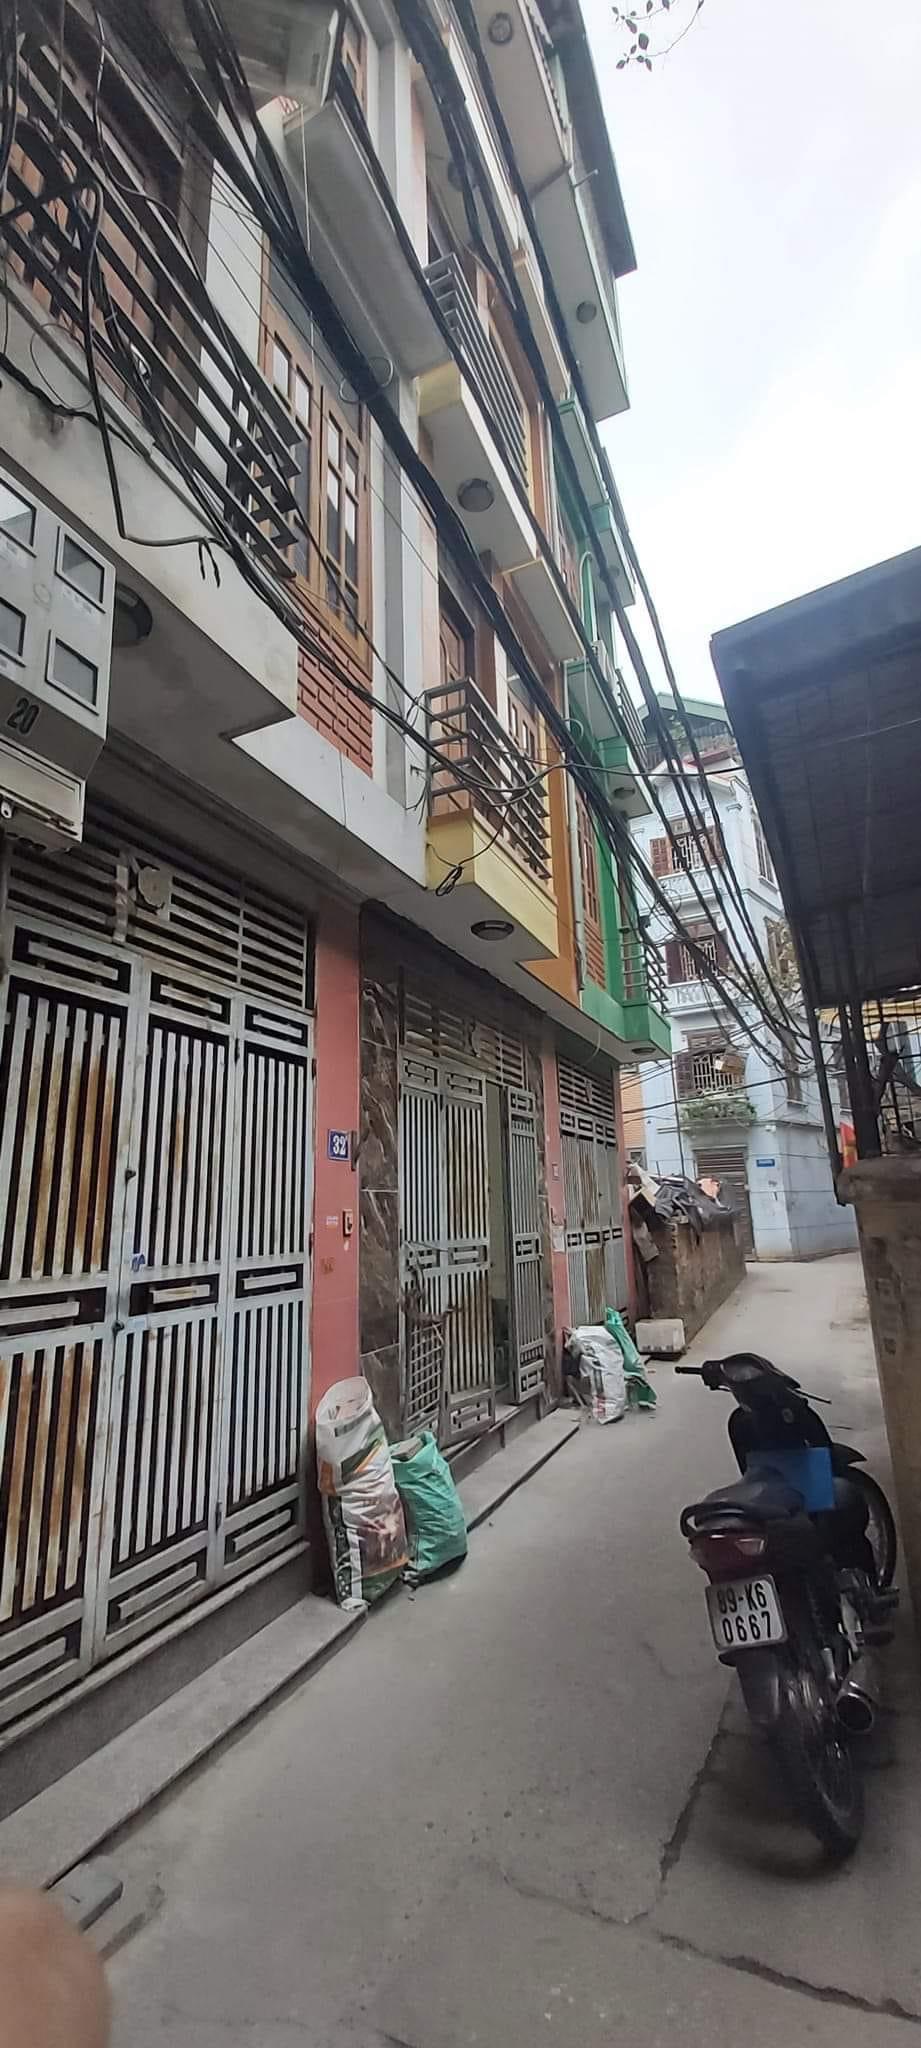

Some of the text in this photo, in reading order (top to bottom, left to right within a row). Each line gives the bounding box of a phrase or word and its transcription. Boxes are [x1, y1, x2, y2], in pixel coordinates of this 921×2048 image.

[6, 697, 40, 735] 20
[717, 1582, 767, 1614] 89-K6
[722, 1611, 771, 1643] 0667
